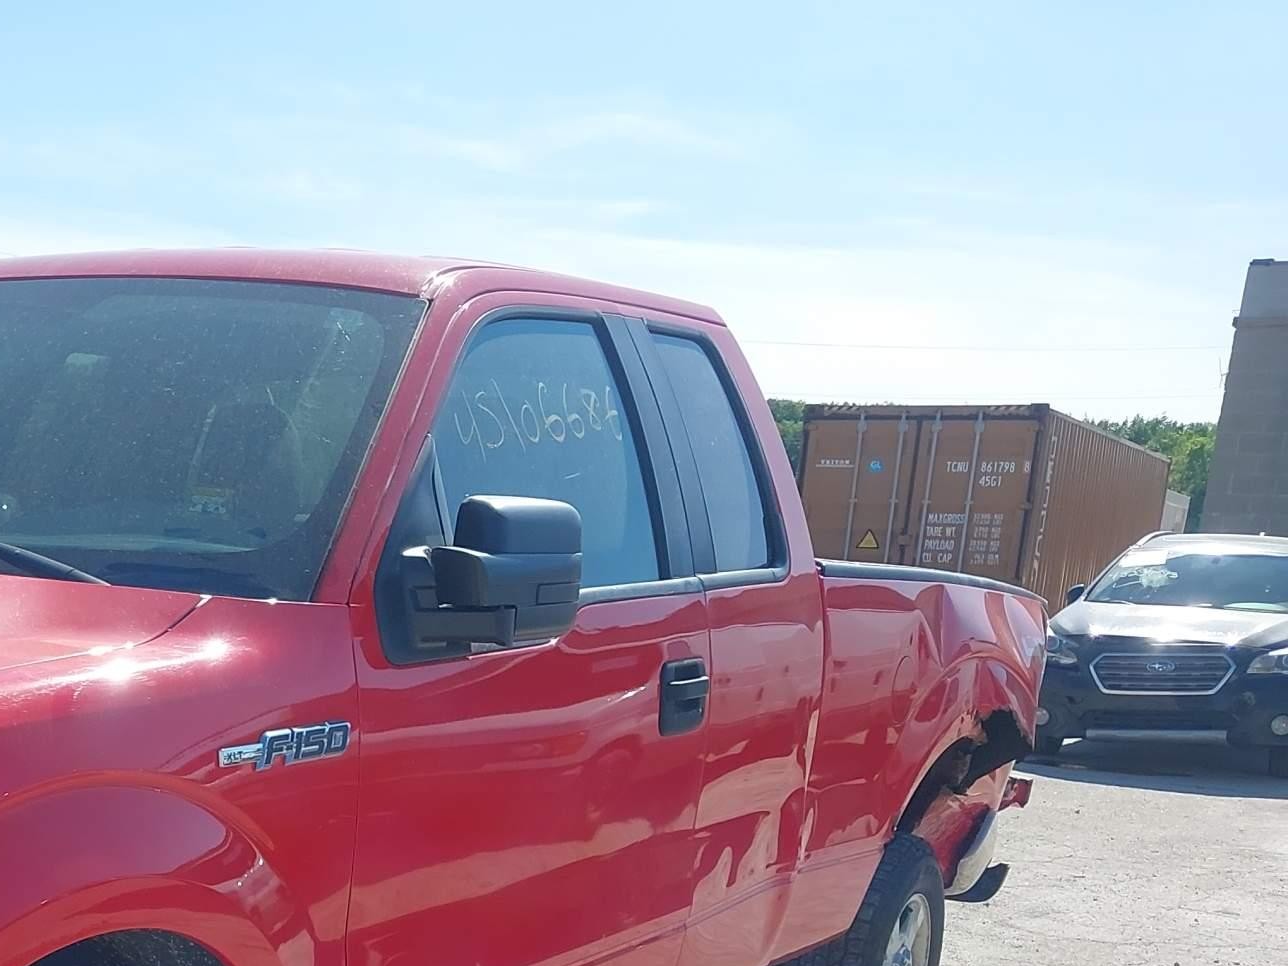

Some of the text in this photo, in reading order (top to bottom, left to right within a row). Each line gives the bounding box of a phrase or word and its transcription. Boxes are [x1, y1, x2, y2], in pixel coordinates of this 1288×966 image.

[946, 461, 969, 473] TCNU
[980, 461, 1016, 473] 861798
[979, 475, 1002, 487] 45G1
[926, 526, 943, 537] TARE
[923, 539, 955, 550] PAYLOAD
